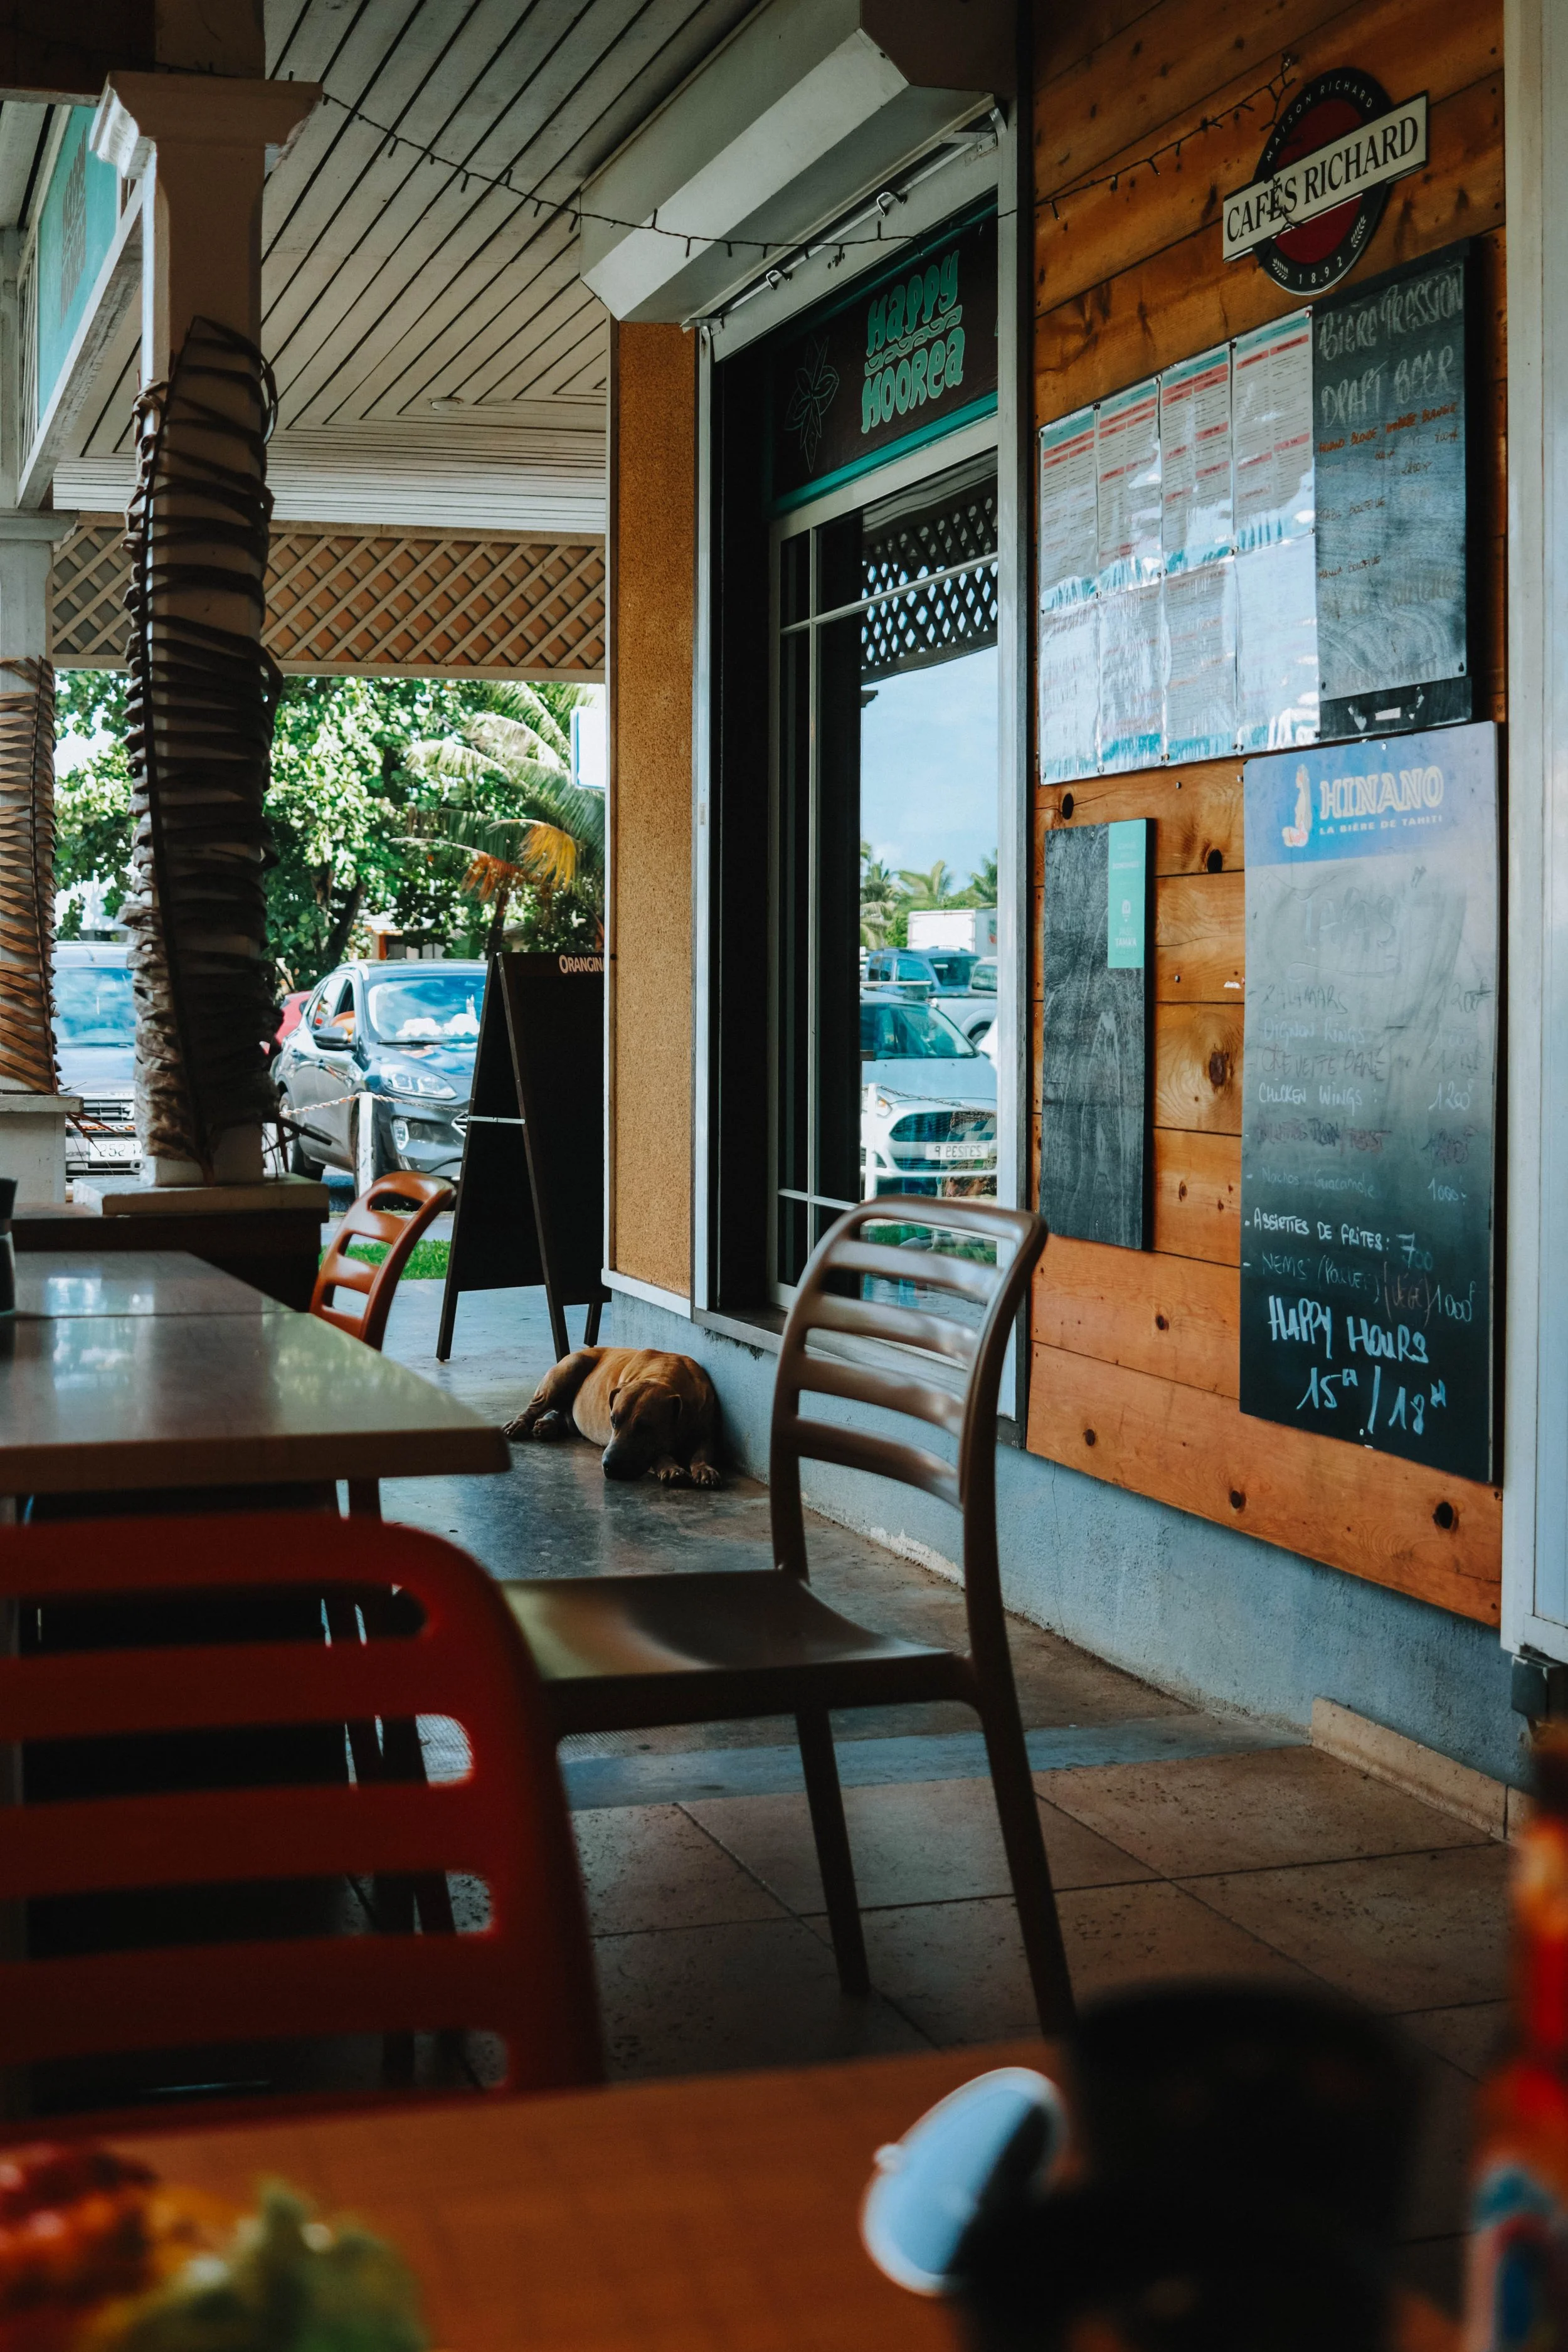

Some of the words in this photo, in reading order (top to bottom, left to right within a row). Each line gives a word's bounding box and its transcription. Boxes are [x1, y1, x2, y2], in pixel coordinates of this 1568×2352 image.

[1266, 95, 1312, 162] MAISON
[1320, 79, 1374, 109] RICHARD
[1303, 116, 1419, 207] RICHARD
[1320, 765, 1444, 820] HINANO
[1320, 827, 1335, 835] LA
[1380, 819, 1397, 829] DE
[1402, 815, 1443, 827] TAHITI
[1317, 1221, 1333, 1240] DE
[1267, 1295, 1332, 1360] HAPPY
[1346, 1316, 1429, 1364] HOURS
